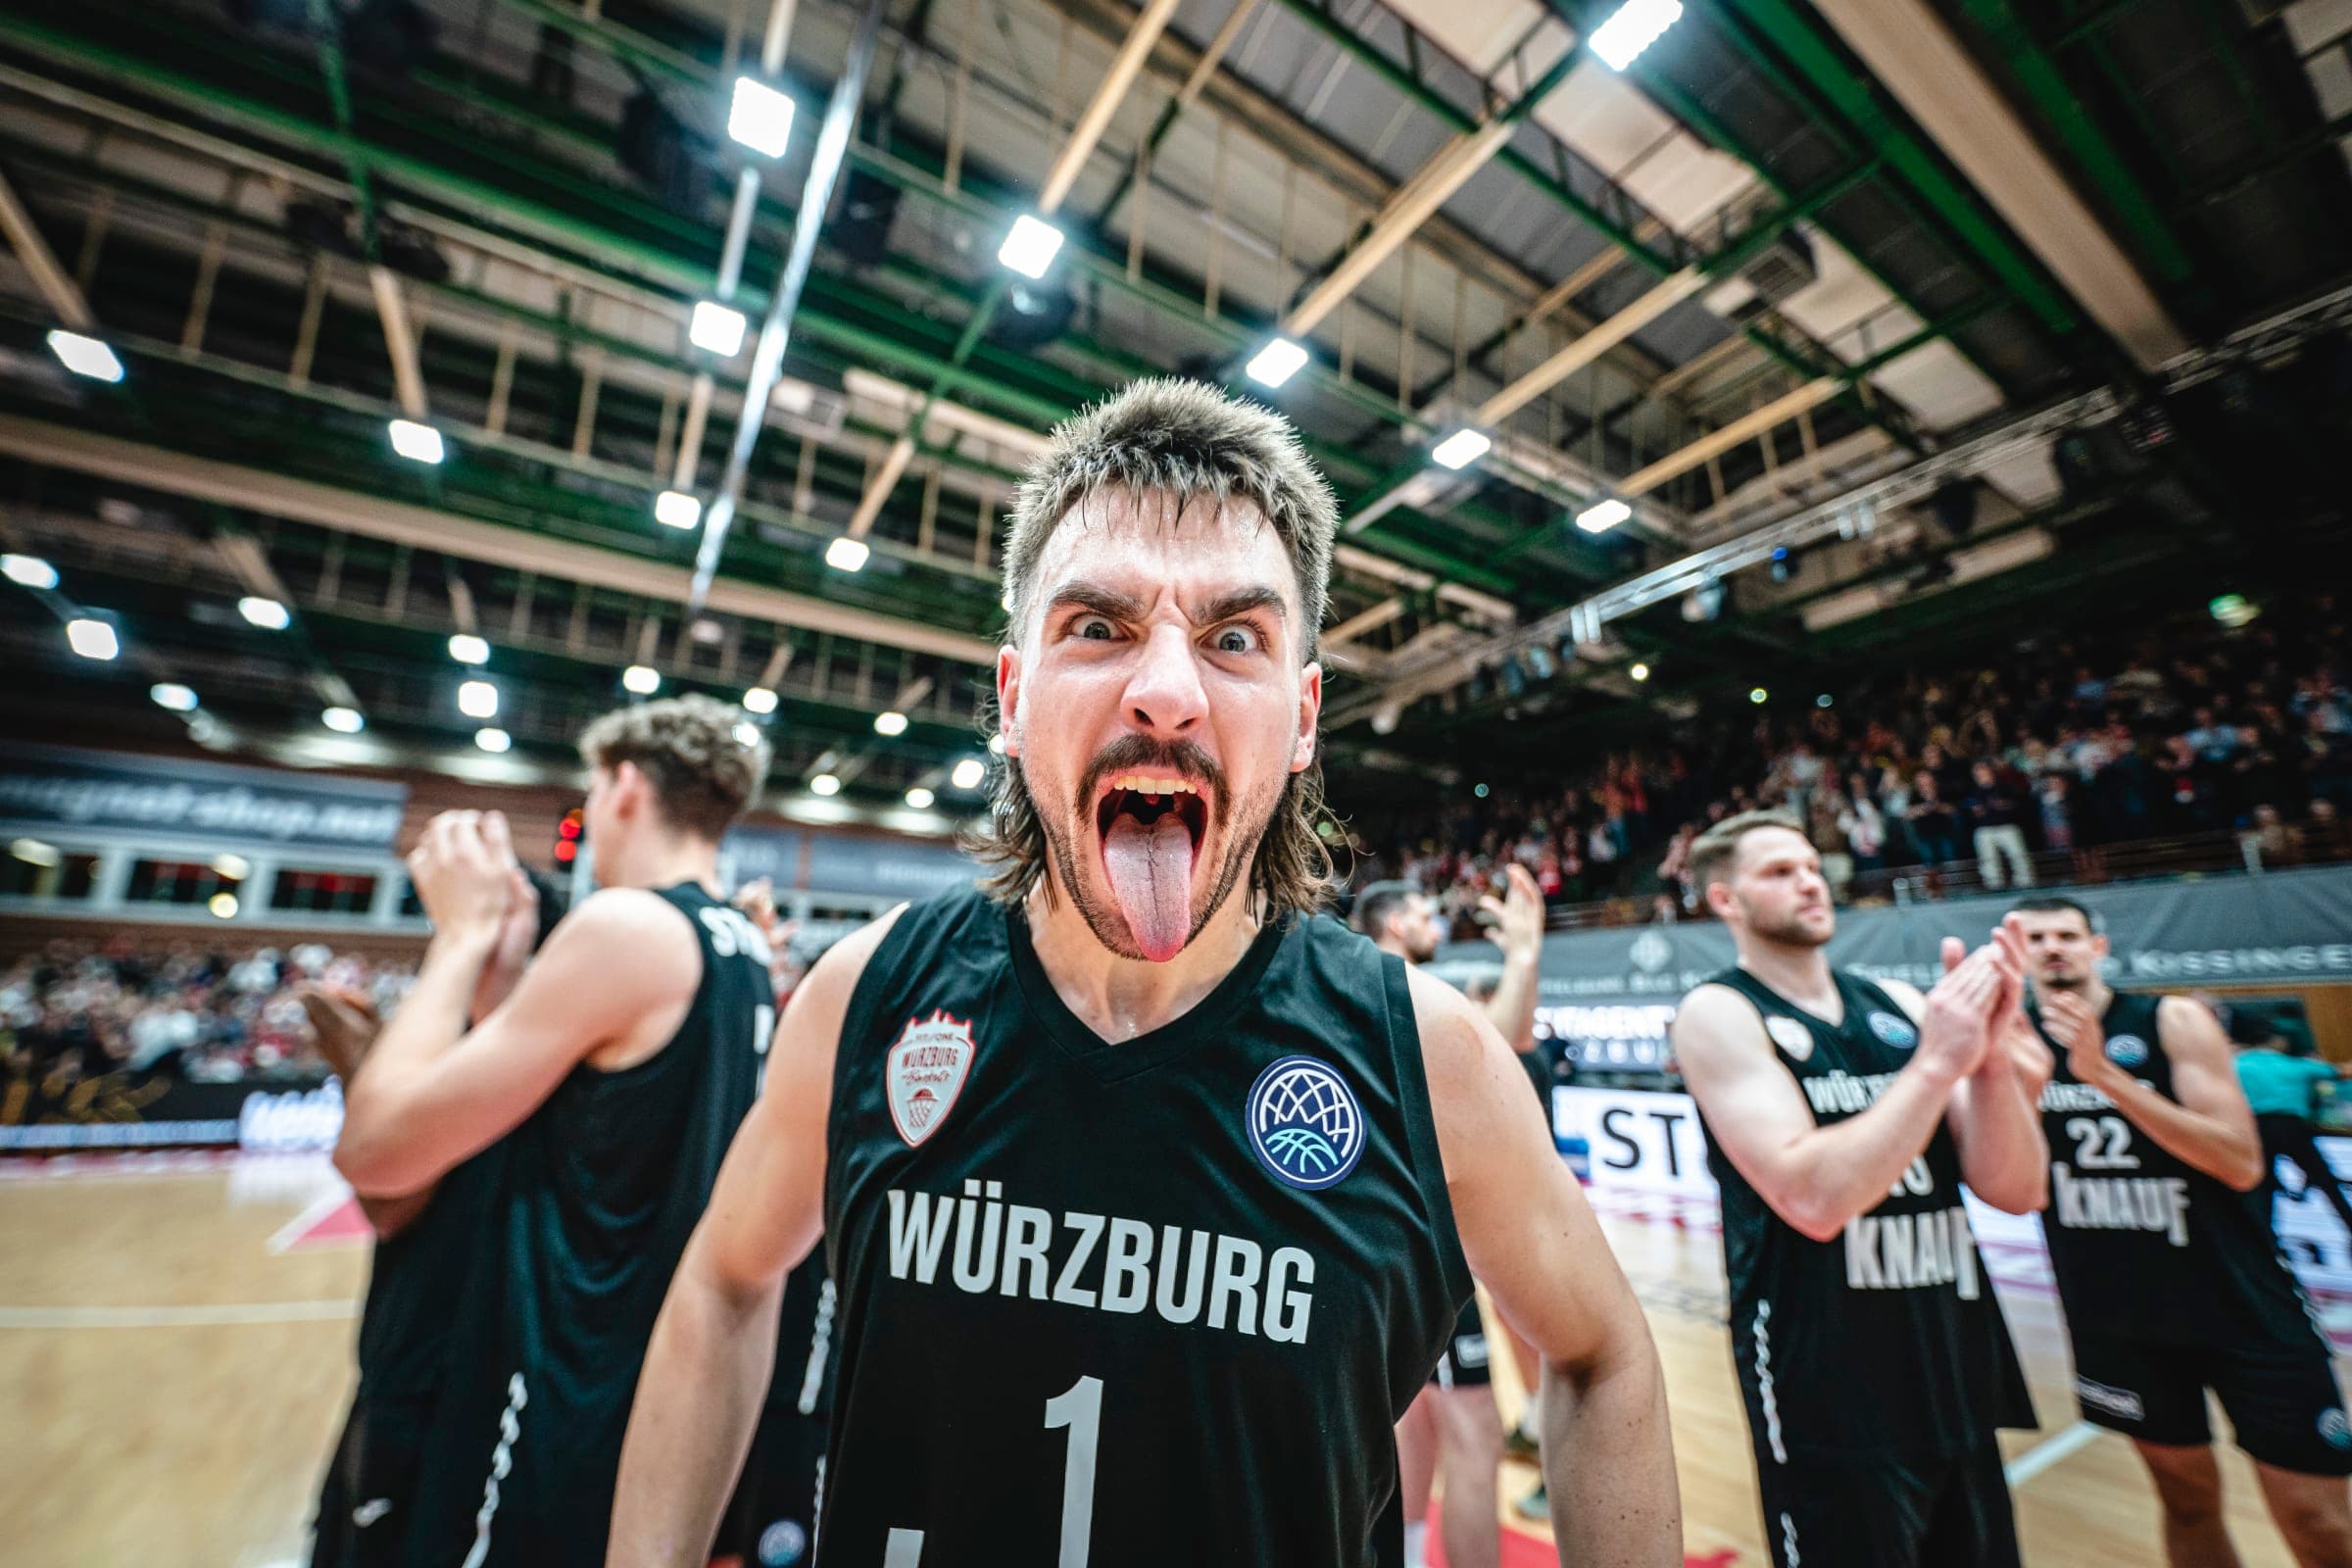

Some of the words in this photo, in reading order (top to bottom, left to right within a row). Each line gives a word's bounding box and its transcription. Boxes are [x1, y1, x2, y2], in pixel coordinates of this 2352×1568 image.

[2131, 944, 2352, 978] KISSINGE
[2065, 1115, 2141, 1169] 22
[2051, 1160, 2190, 1247] KNAUF
[887, 1178, 1315, 1345] WÜRZBURG
[1044, 1375, 1104, 1568] 1
